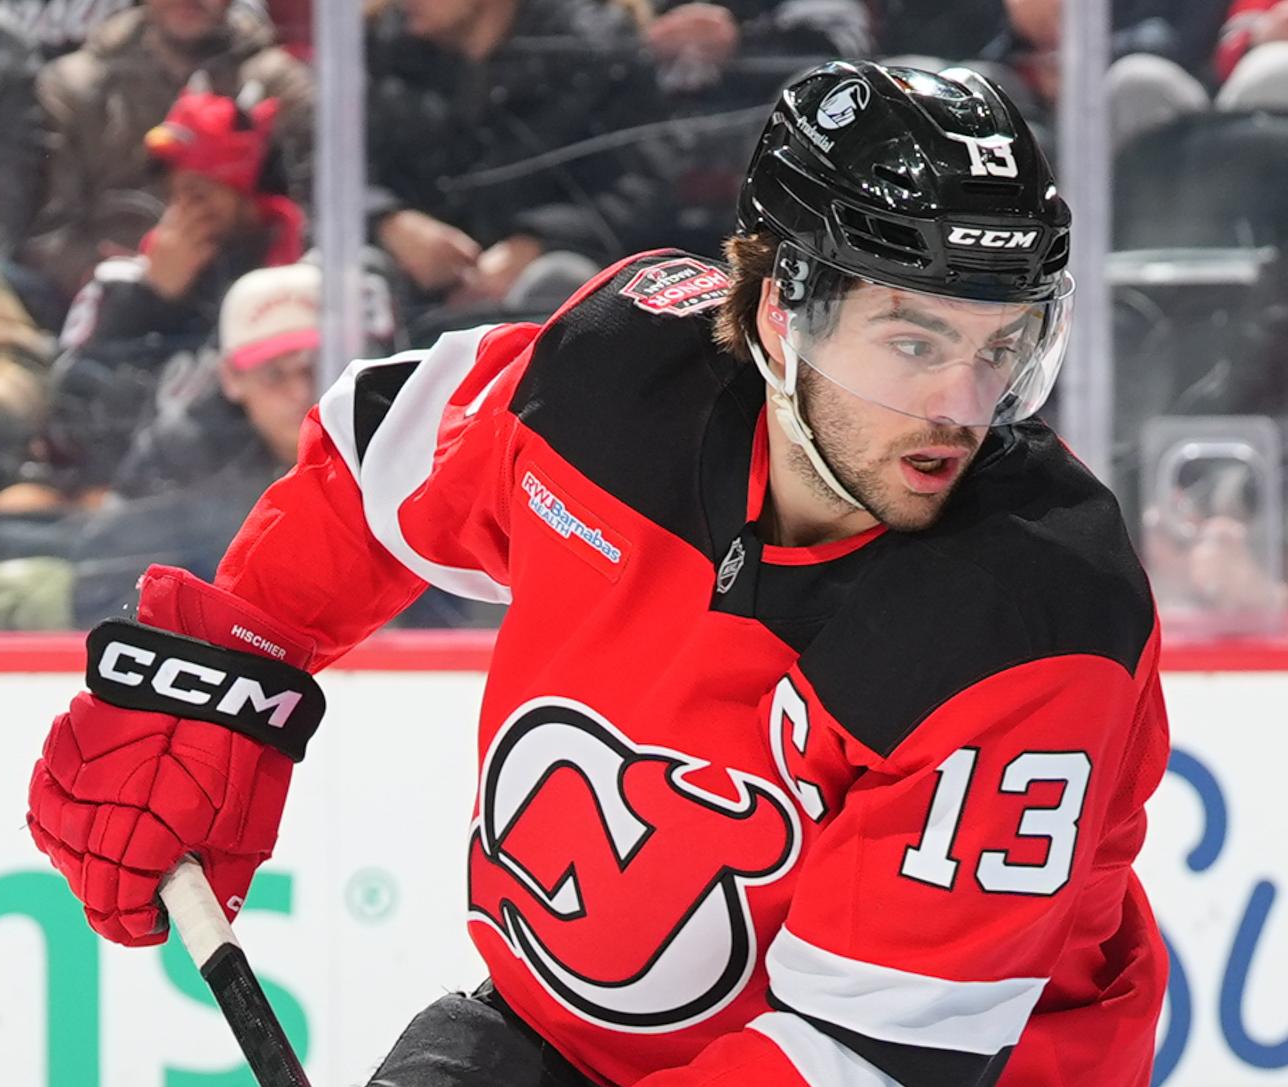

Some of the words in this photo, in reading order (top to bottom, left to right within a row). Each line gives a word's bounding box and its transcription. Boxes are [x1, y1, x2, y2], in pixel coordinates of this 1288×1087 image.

[966, 139, 1018, 178] 13
[948, 226, 1038, 249] CCM
[647, 273, 725, 307] HONOR
[529, 498, 570, 537] HEALTH
[230, 624, 287, 660] HISCHIER
[98, 641, 303, 728] CCM
[769, 674, 826, 823] C
[899, 747, 1092, 896] 13
